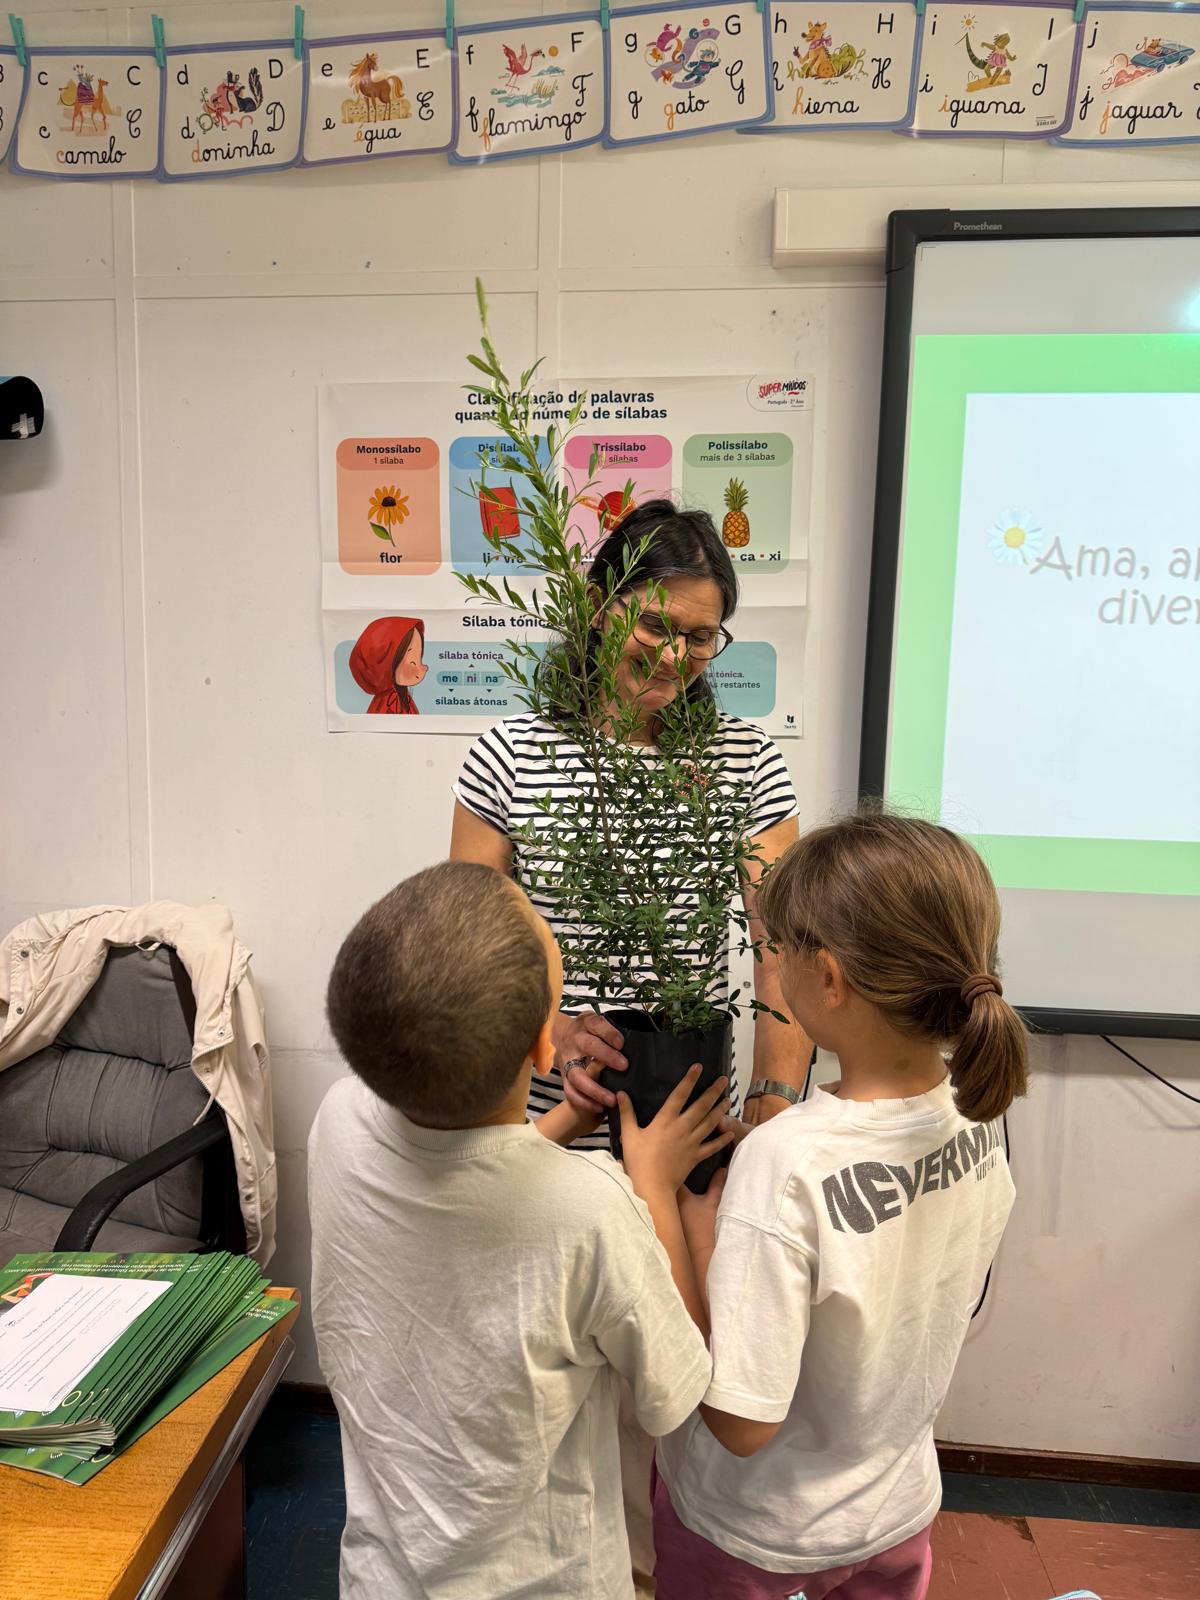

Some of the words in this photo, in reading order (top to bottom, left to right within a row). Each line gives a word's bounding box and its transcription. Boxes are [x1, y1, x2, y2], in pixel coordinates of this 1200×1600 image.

[725, 14, 742, 35] G
[774, 12, 787, 33] h
[877, 13, 894, 34] H
[931, 14, 938, 36] i
[571, 32, 584, 52] F
[625, 33, 638, 52] g
[1087, 21, 1099, 48] j
[416, 49, 430, 68] E
[466, 45, 474, 65] f
[38, 71, 48, 85] c
[127, 66, 141, 85] C
[177, 64, 188, 85] d
[269, 60, 283, 78] D
[321, 63, 333, 76] e
[871, 57, 892, 89] H
[572, 72, 593, 107] F
[919, 74, 934, 93] i
[416, 91, 434, 120] E
[628, 90, 642, 119] g
[664, 91, 709, 130] gato
[792, 86, 859, 115] hiena
[1079, 86, 1094, 120] j
[266, 102, 285, 132] D
[465, 97, 479, 132] f
[938, 94, 1025, 128] iguana
[1099, 101, 1182, 134] jaguar
[39, 126, 51, 138] c
[126, 109, 142, 138] C
[181, 116, 195, 140] d
[322, 117, 336, 130] e
[479, 108, 587, 152] flamingo
[191, 130, 275, 163] doninha
[354, 124, 402, 153] égua
[56, 136, 126, 165] camelo
[953, 221, 1003, 231] Promethean
[468, 391, 564, 407] Clasifiação
[591, 390, 654, 406] palavras
[759, 382, 781, 398] SUPER
[455, 409, 501, 423] quant
[533, 407, 588, 420] númeo
[593, 407, 610, 419] de
[615, 406, 667, 419] sílabas
[356, 444, 421, 454] Monossílabo
[594, 443, 646, 451] Trissílabo
[708, 441, 768, 450] Polissílabo
[380, 456, 404, 465] sílaba
[609, 454, 638, 463] sílabas
[723, 453, 734, 461] de
[737, 453, 742, 461] 3
[745, 452, 775, 461] sílabas
[380, 552, 402, 563] flor
[482, 552, 490, 563] li
[740, 553, 755, 561] ca
[769, 551, 781, 561] xi
[1029, 535, 1150, 581] Ama,
[1168, 546, 1200, 581] a
[1098, 588, 1200, 625] dive
[462, 615, 506, 627] Sílaba
[439, 651, 469, 660] sílaba
[472, 651, 504, 660] tónica
[442, 675, 458, 683] me
[467, 674, 477, 683] ni
[485, 675, 498, 683] na
[435, 697, 470, 706] sílabas
[473, 697, 508, 706] átonas
